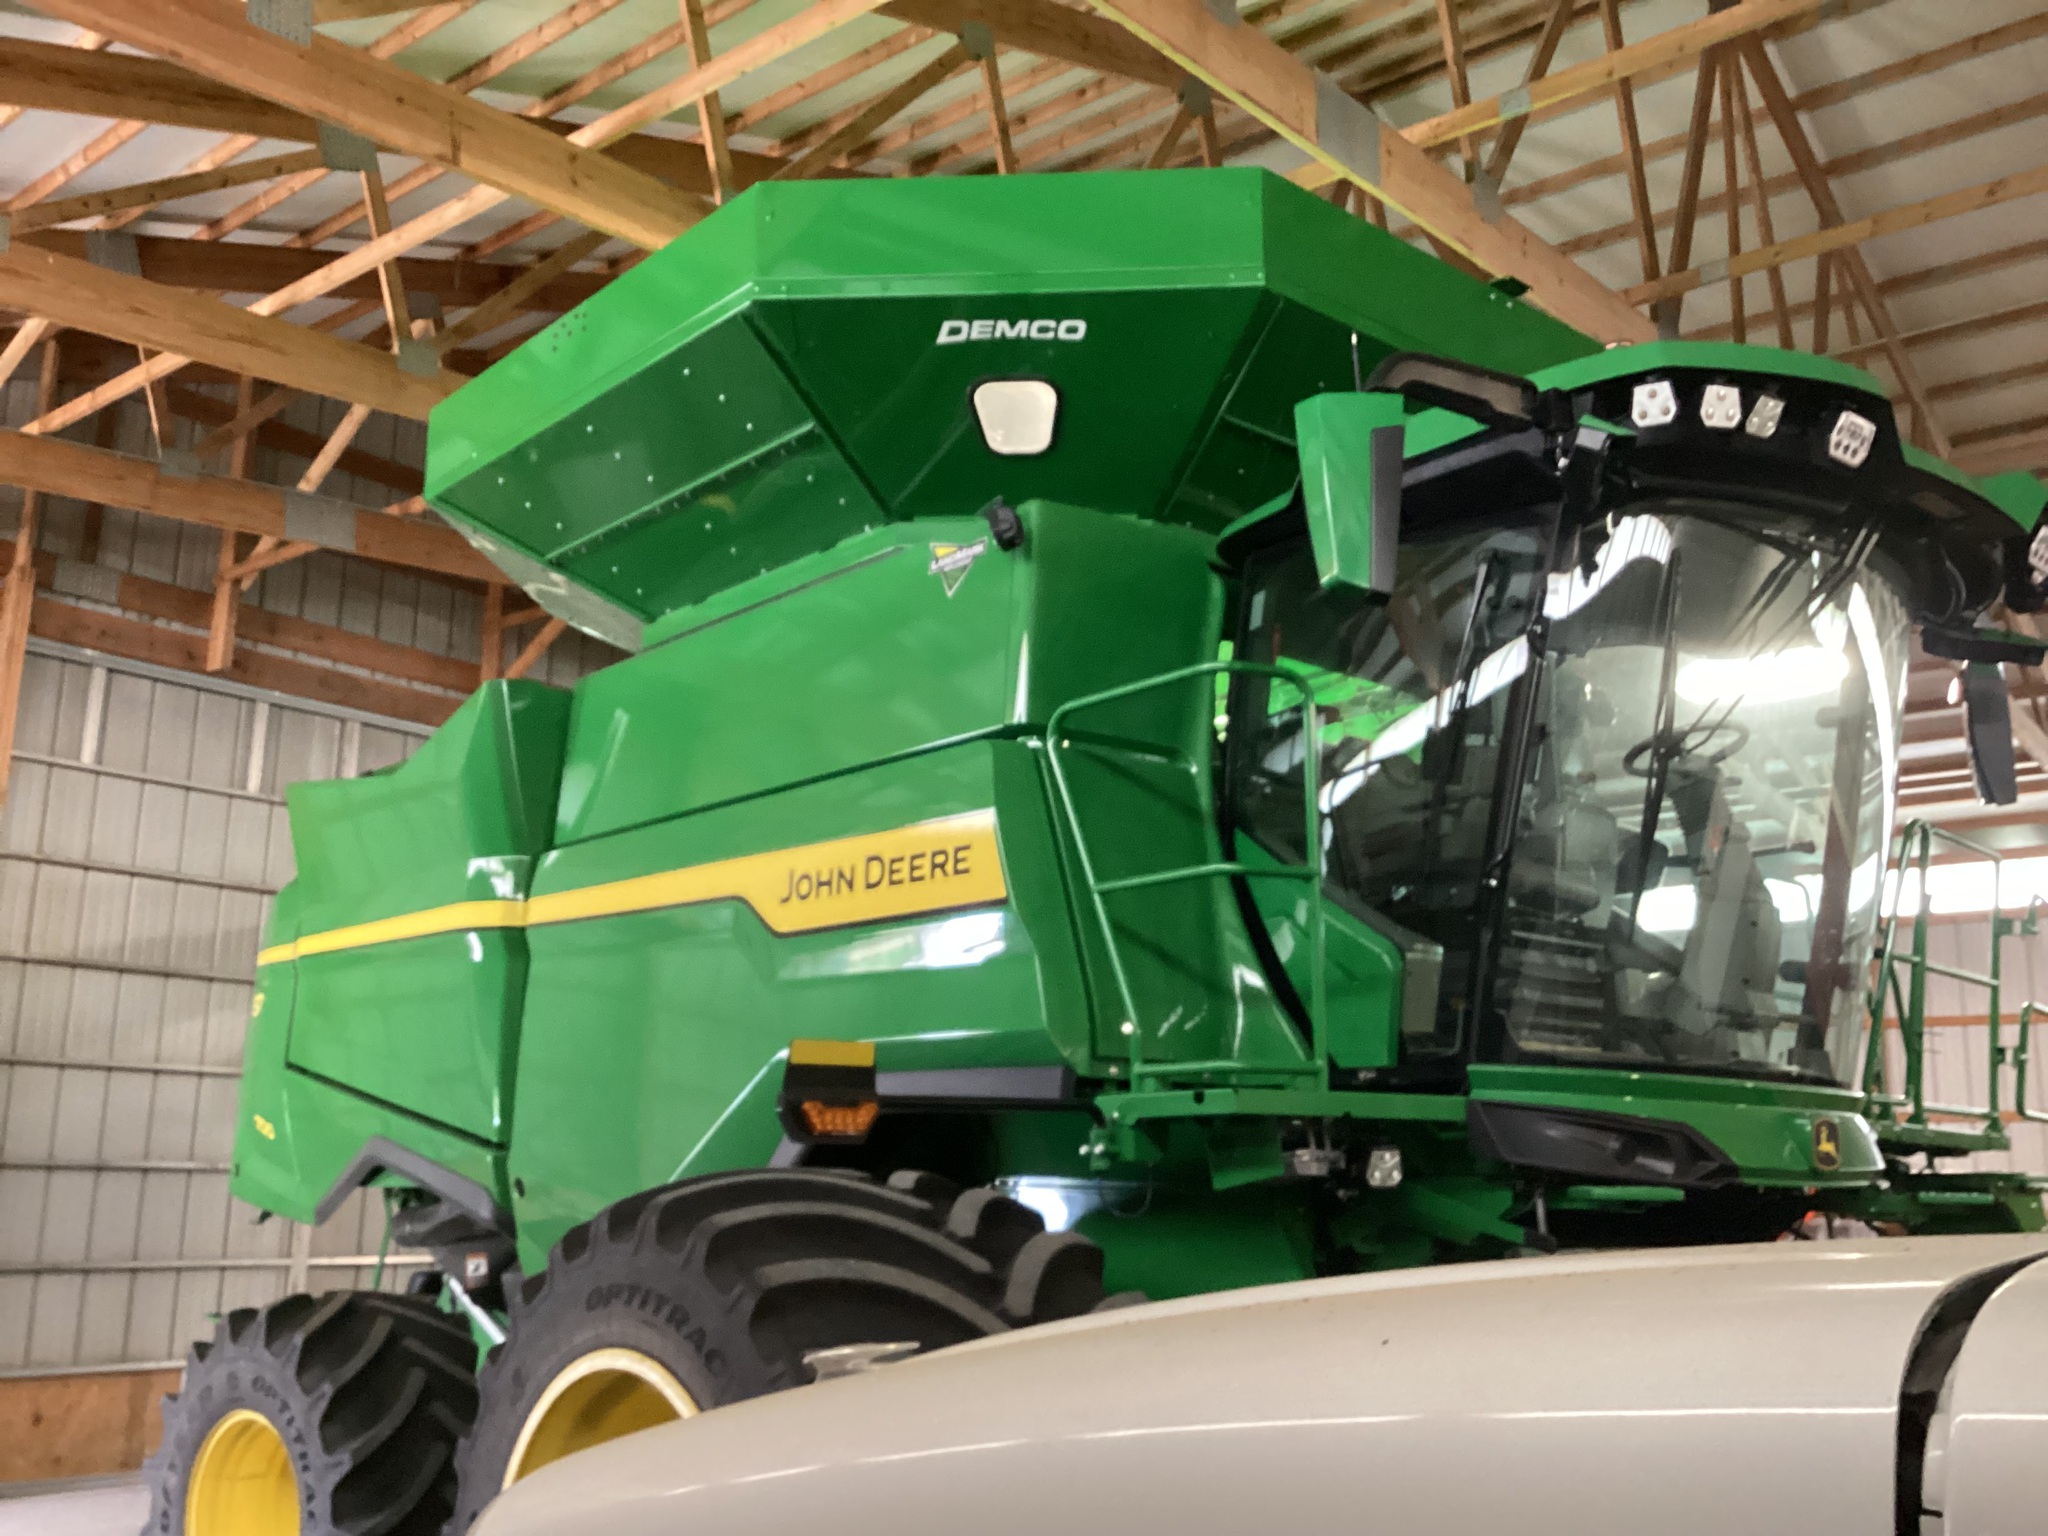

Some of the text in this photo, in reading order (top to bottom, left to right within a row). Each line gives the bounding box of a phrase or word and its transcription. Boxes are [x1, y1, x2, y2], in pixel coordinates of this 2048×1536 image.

[936, 319, 1087, 345] DEMCO
[780, 844, 971, 904] JOHN DEERE
